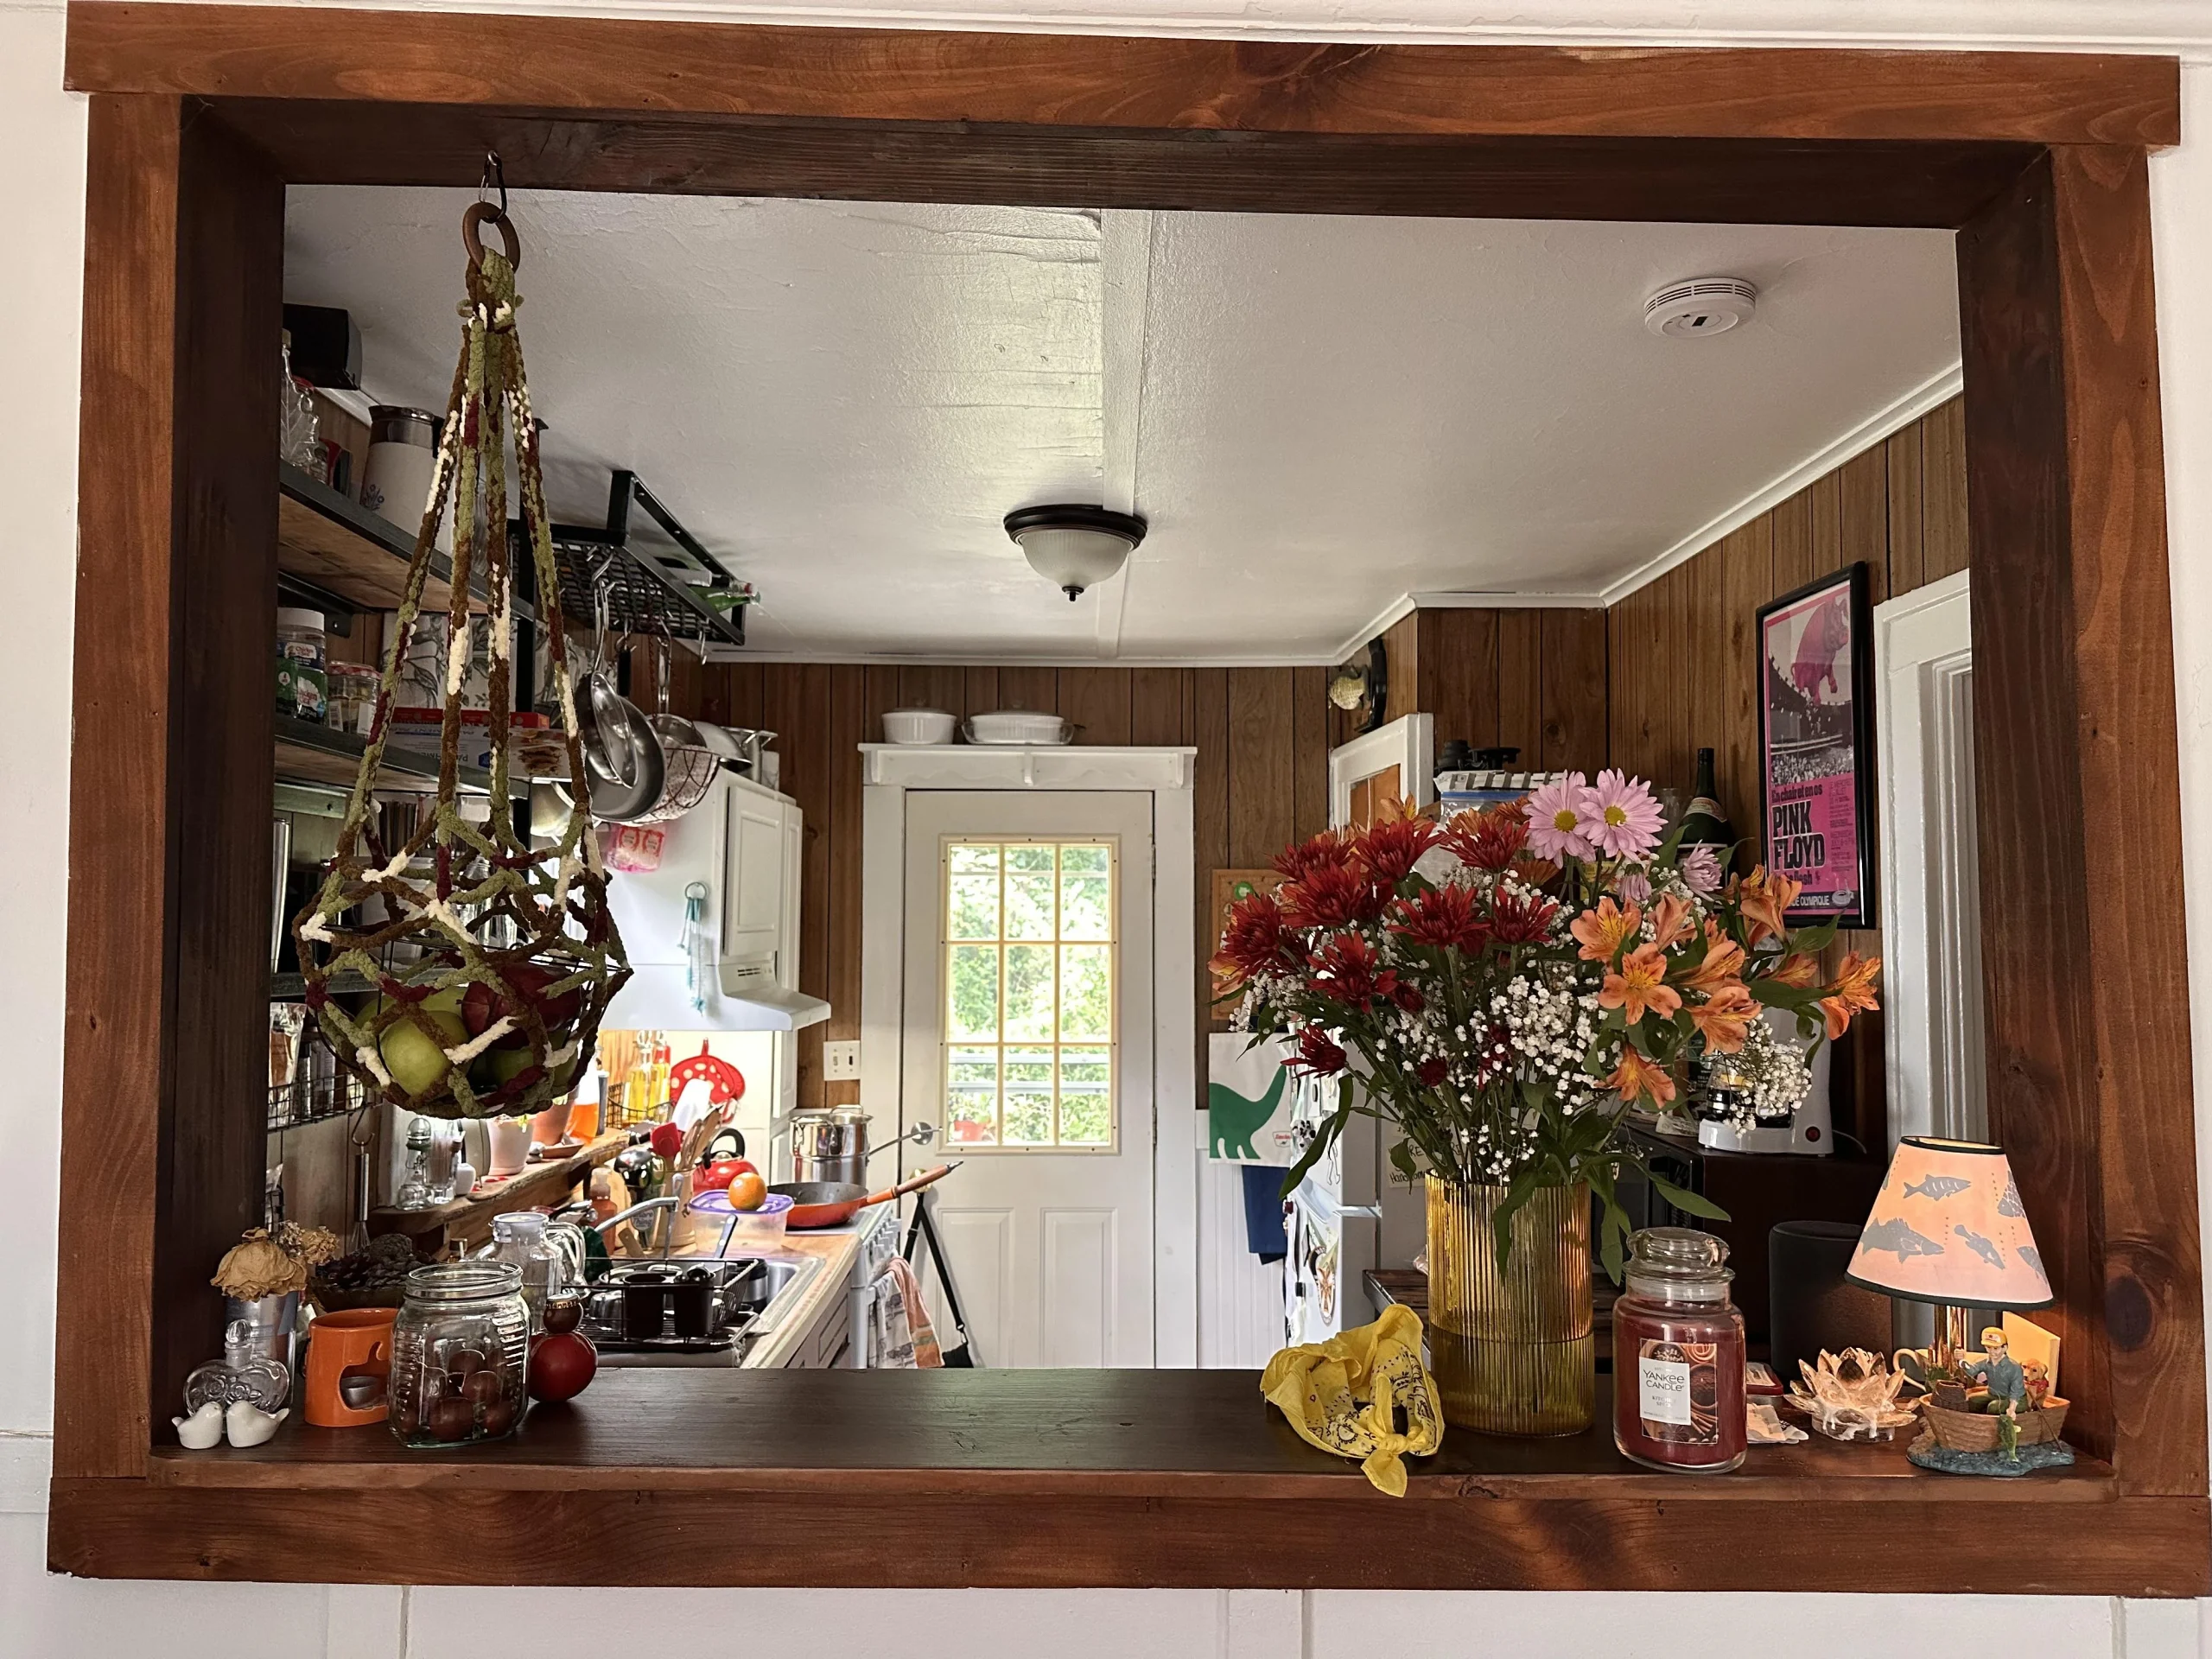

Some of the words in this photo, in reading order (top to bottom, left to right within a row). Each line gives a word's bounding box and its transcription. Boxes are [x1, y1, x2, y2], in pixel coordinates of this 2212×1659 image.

[1781, 786, 1797, 802] chair
[1805, 785, 1814, 798] en
[1815, 784, 1823, 795] os
[1771, 799, 1812, 838] PINK
[1773, 832, 1825, 871] FLOYD
[1800, 895, 1830, 906] OLYMPIQUE
